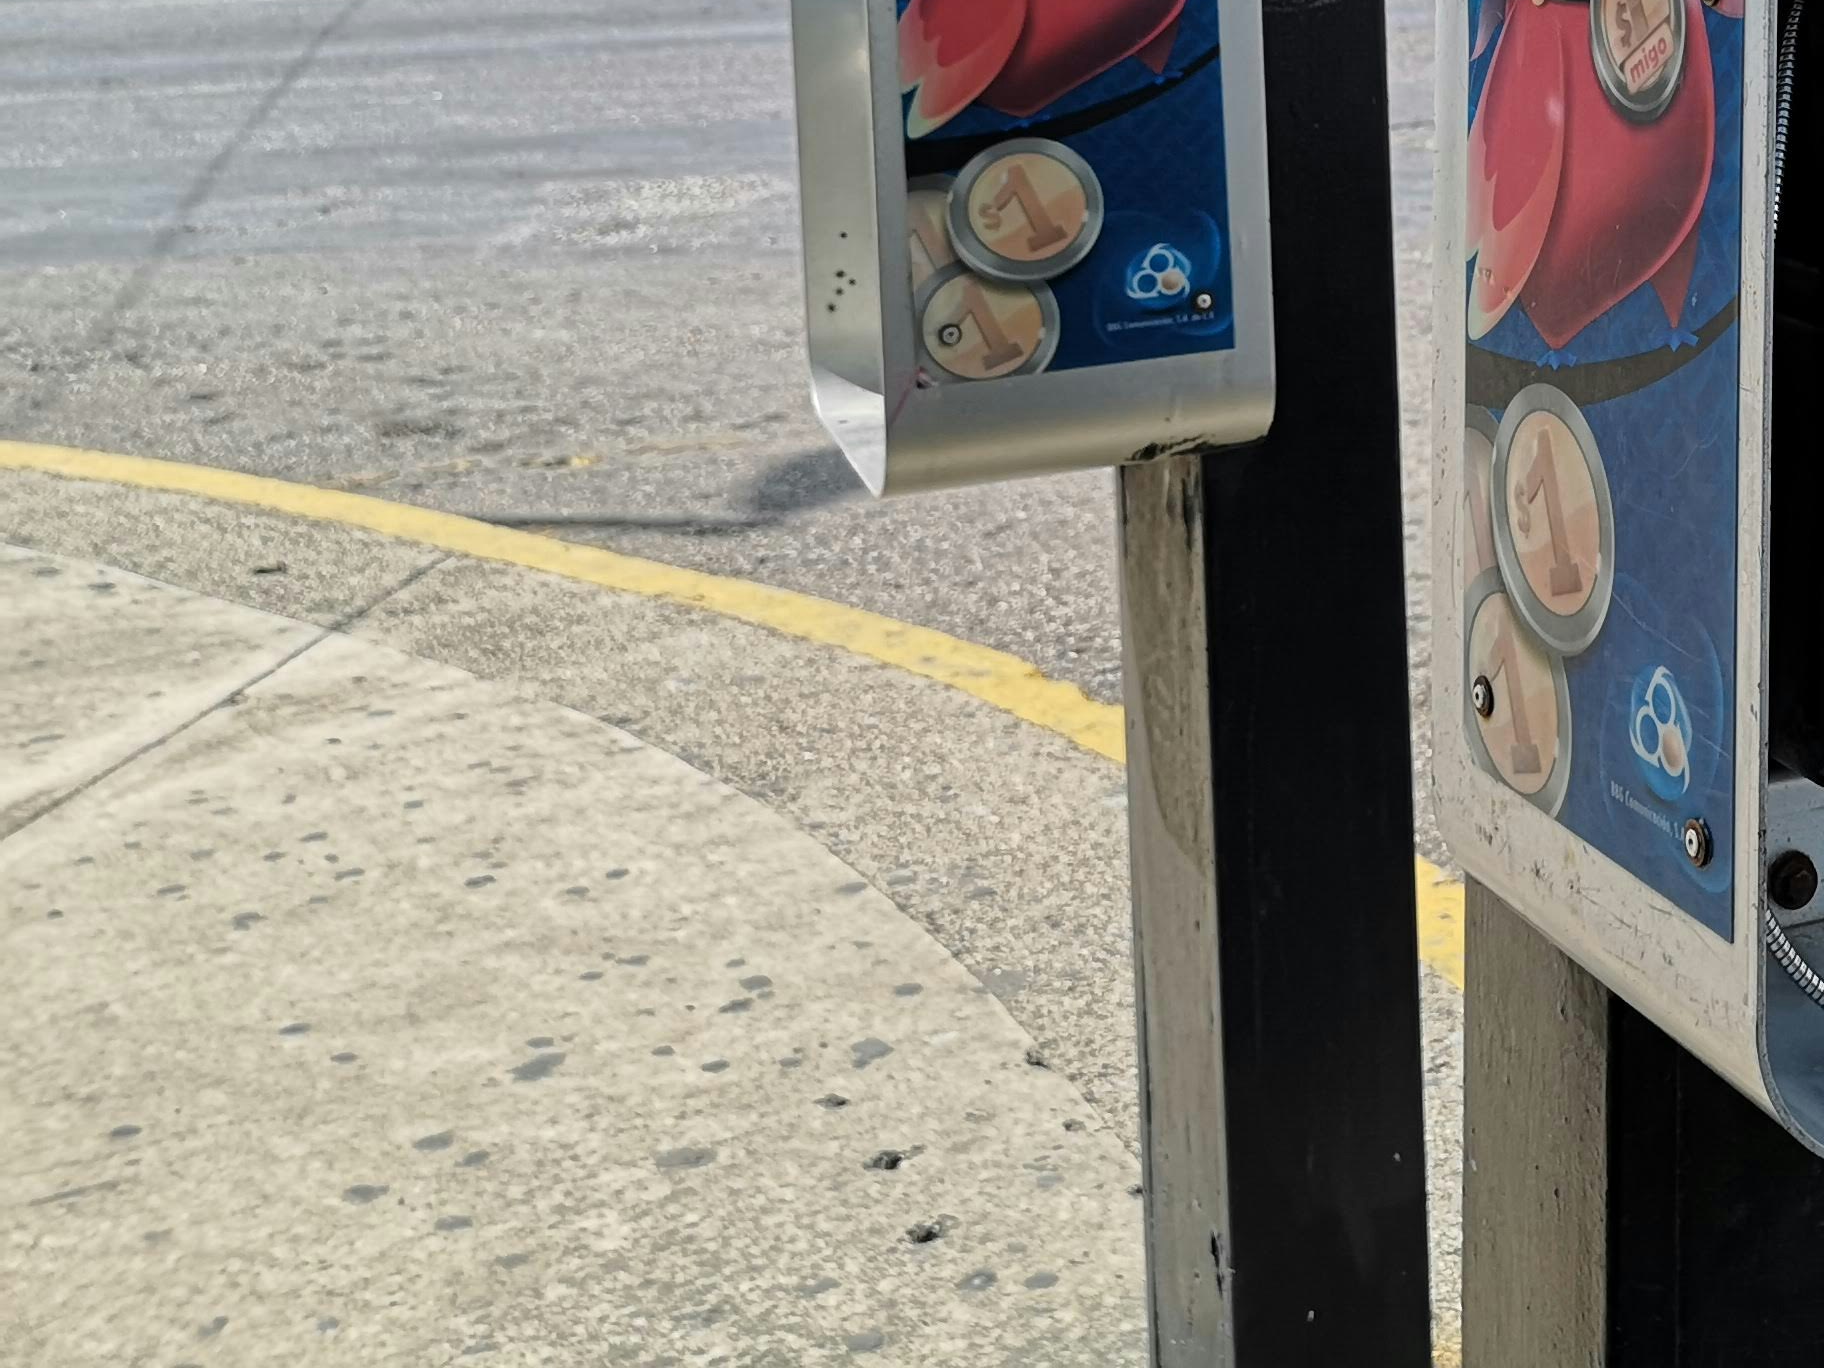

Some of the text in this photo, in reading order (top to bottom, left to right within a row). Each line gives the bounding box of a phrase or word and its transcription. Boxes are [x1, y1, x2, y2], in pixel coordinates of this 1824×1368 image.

[1630, 36, 1667, 82] migo
[978, 164, 1068, 252] $1
[1514, 425, 1584, 596] $1
